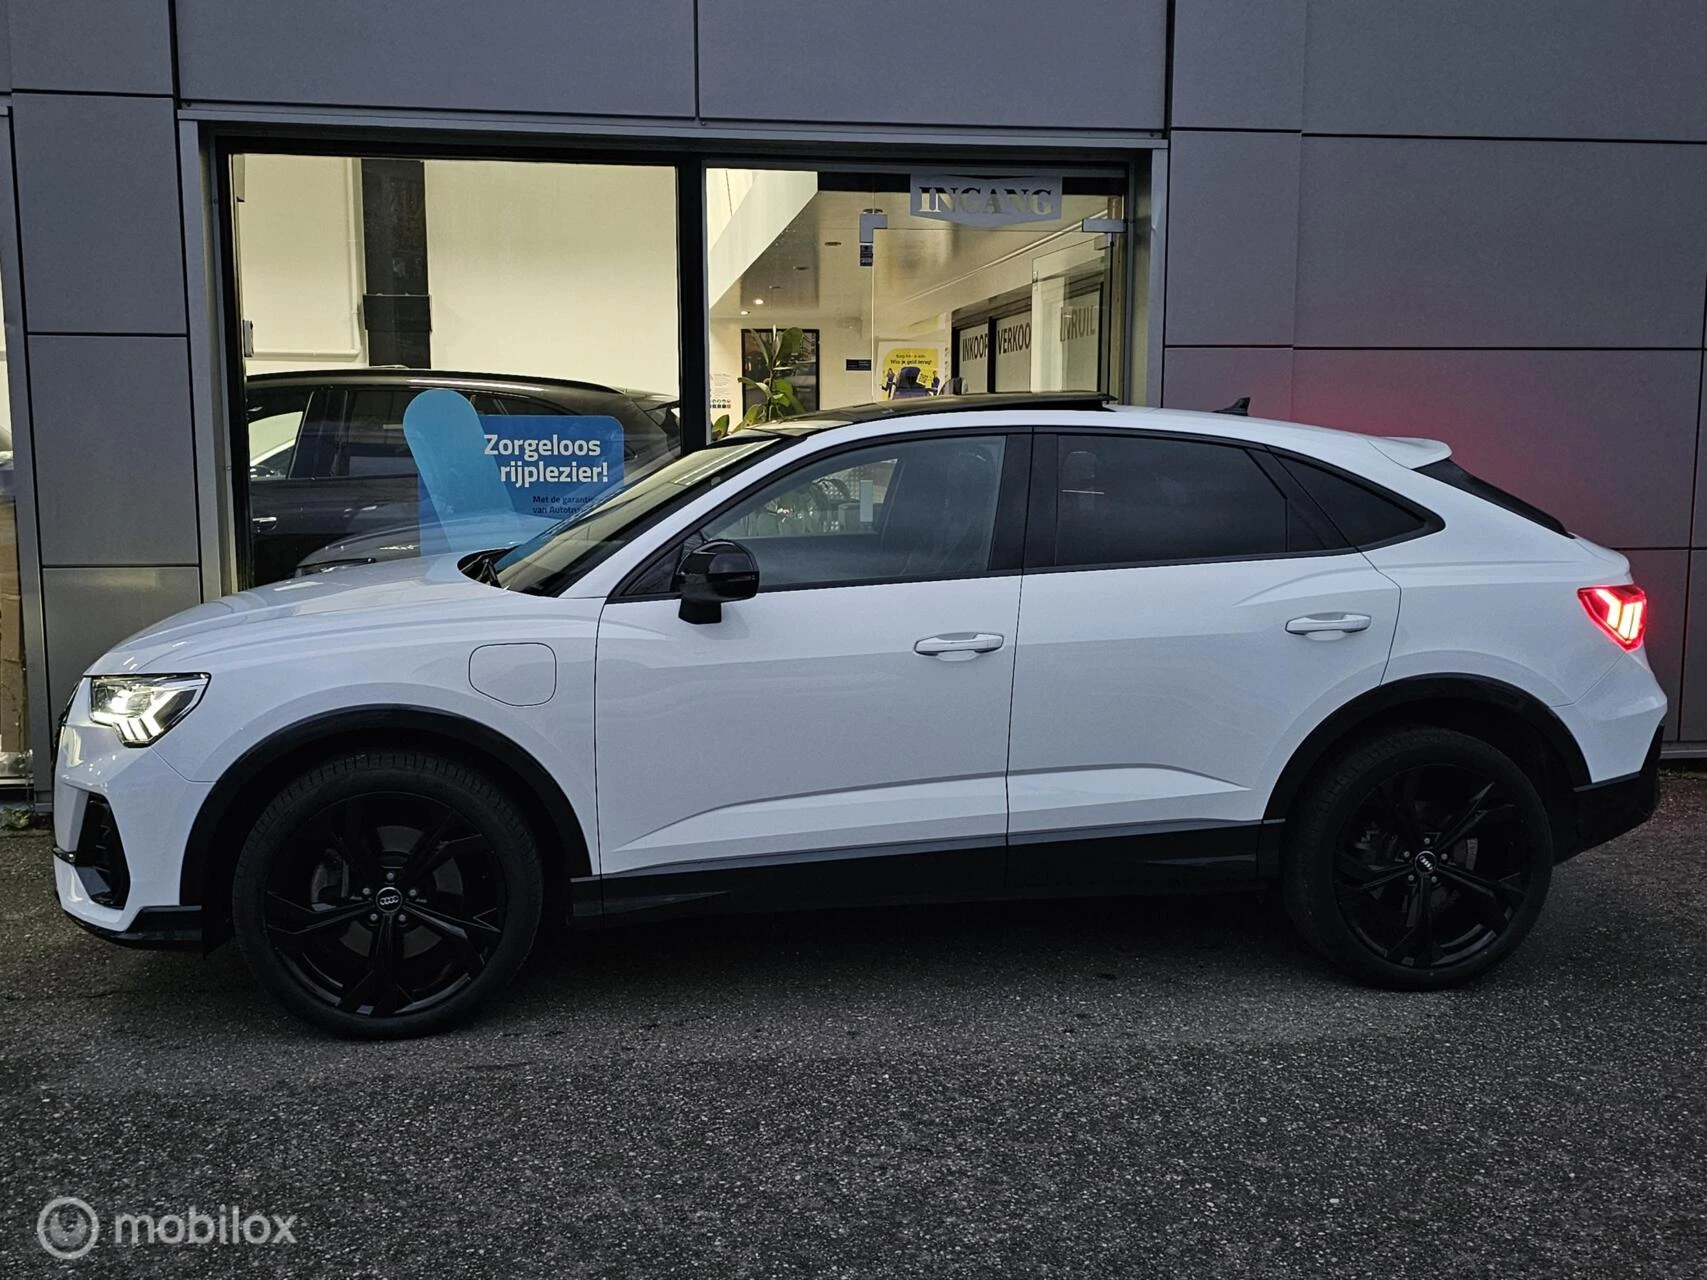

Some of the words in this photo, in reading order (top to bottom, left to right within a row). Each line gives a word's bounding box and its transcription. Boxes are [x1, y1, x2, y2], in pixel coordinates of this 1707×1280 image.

[919, 186, 1052, 215] INCANG
[997, 321, 1032, 355] VERKOO
[484, 434, 600, 461] Zorgeloos
[501, 462, 608, 488] rijplezier!
[532, 496, 549, 504] Met
[550, 496, 561, 504] de
